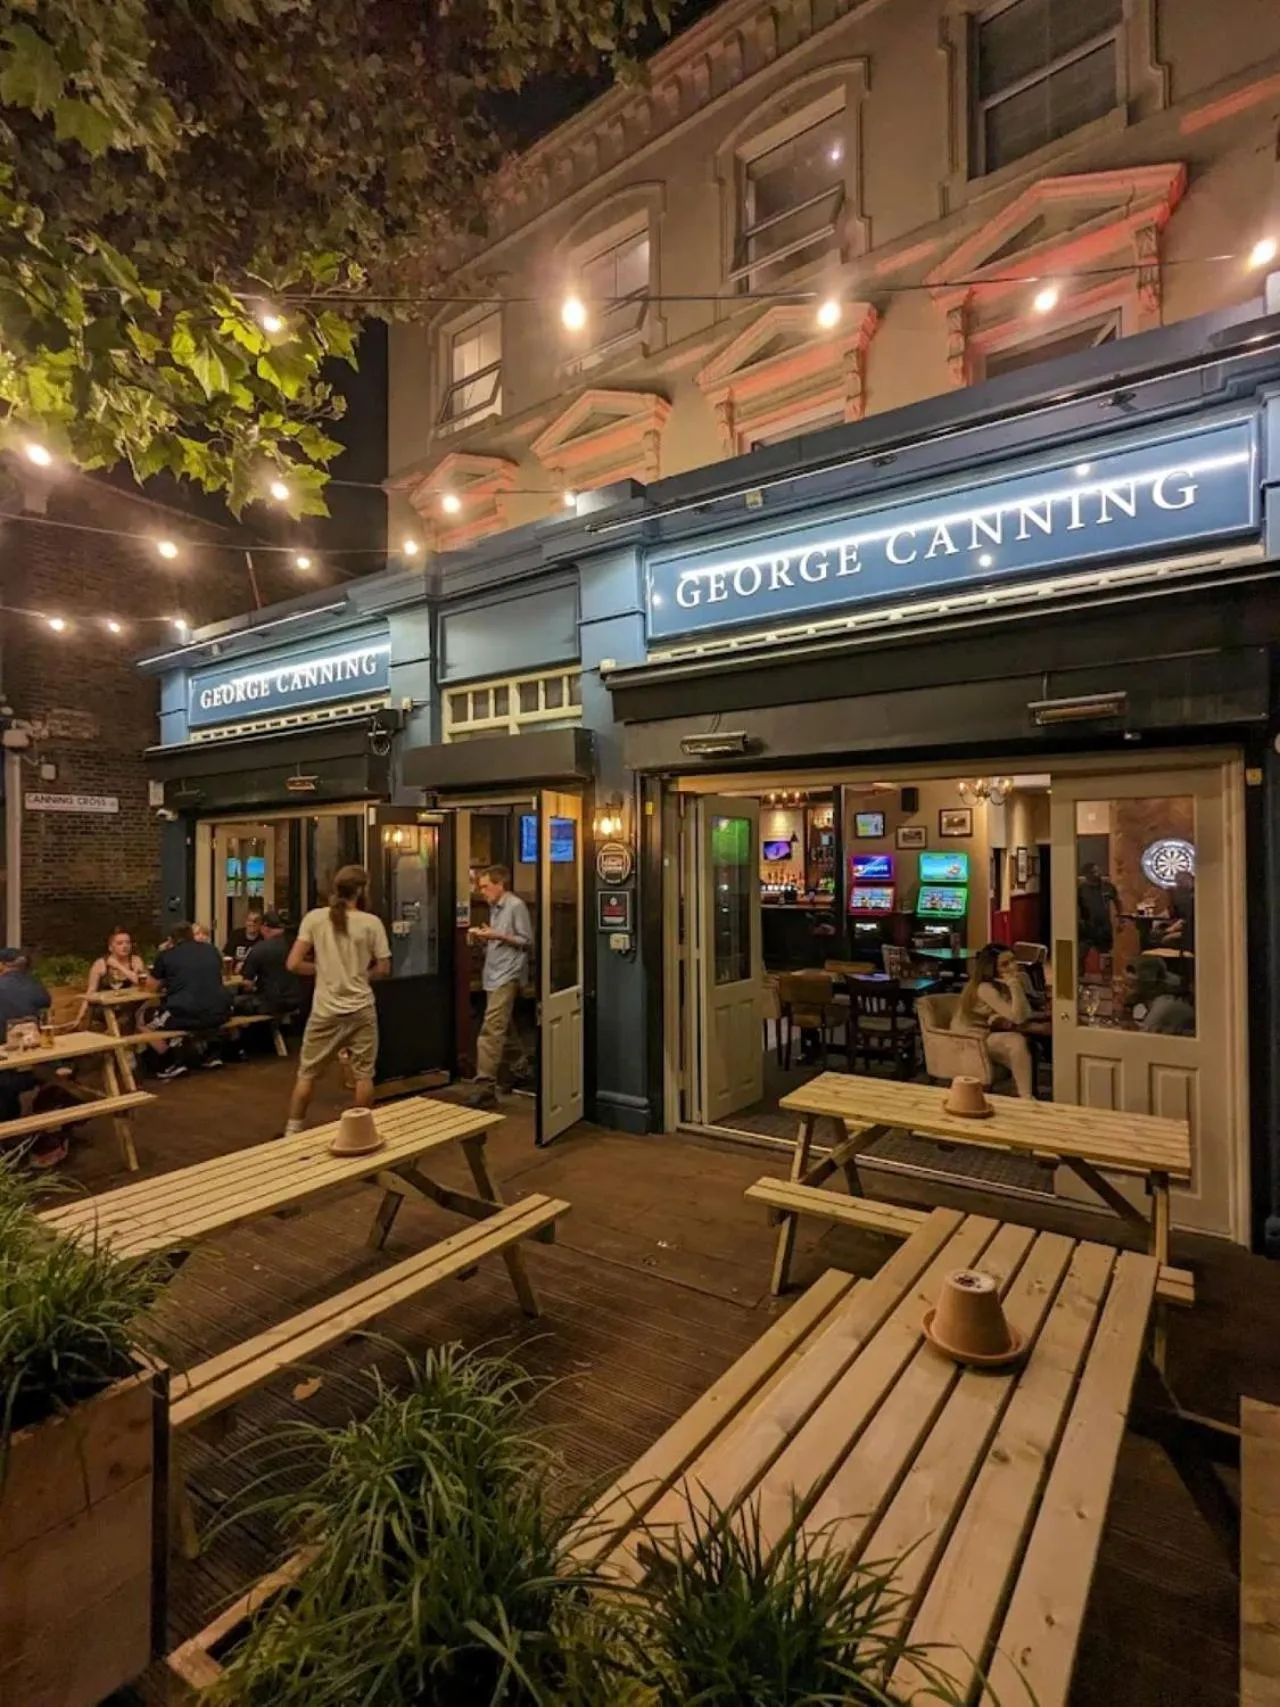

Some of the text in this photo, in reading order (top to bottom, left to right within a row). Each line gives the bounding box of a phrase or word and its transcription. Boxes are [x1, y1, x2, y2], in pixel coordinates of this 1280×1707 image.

[676, 469, 1199, 609] GEORGE CANNING
[200, 653, 377, 709] GEORGE CANNING
